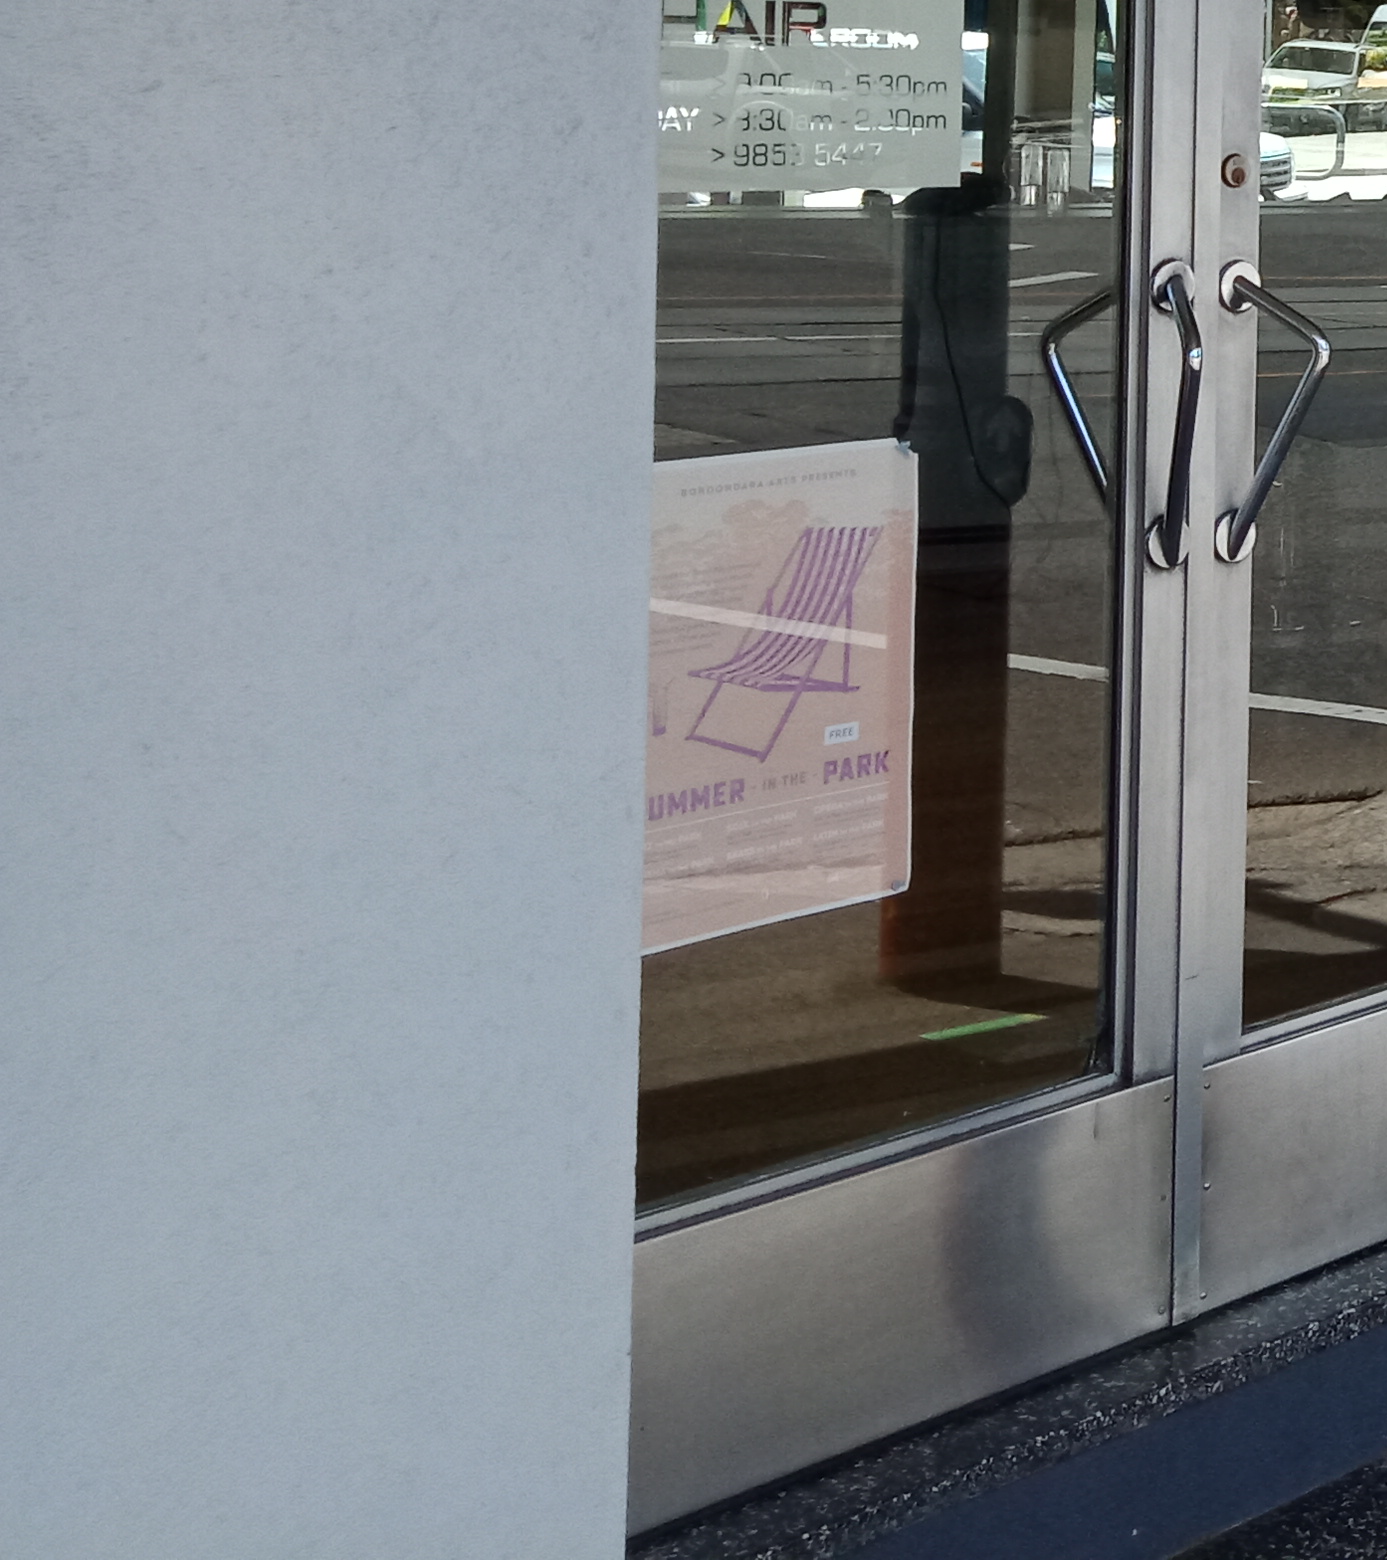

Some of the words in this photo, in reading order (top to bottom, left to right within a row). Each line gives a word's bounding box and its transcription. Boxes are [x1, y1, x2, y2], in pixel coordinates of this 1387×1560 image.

[856, 73, 948, 102] 5:30pm
[656, 105, 701, 132] AY
[828, 726, 854, 739] FREE
[780, 771, 807, 786] THE
[823, 750, 890, 785] PARK
